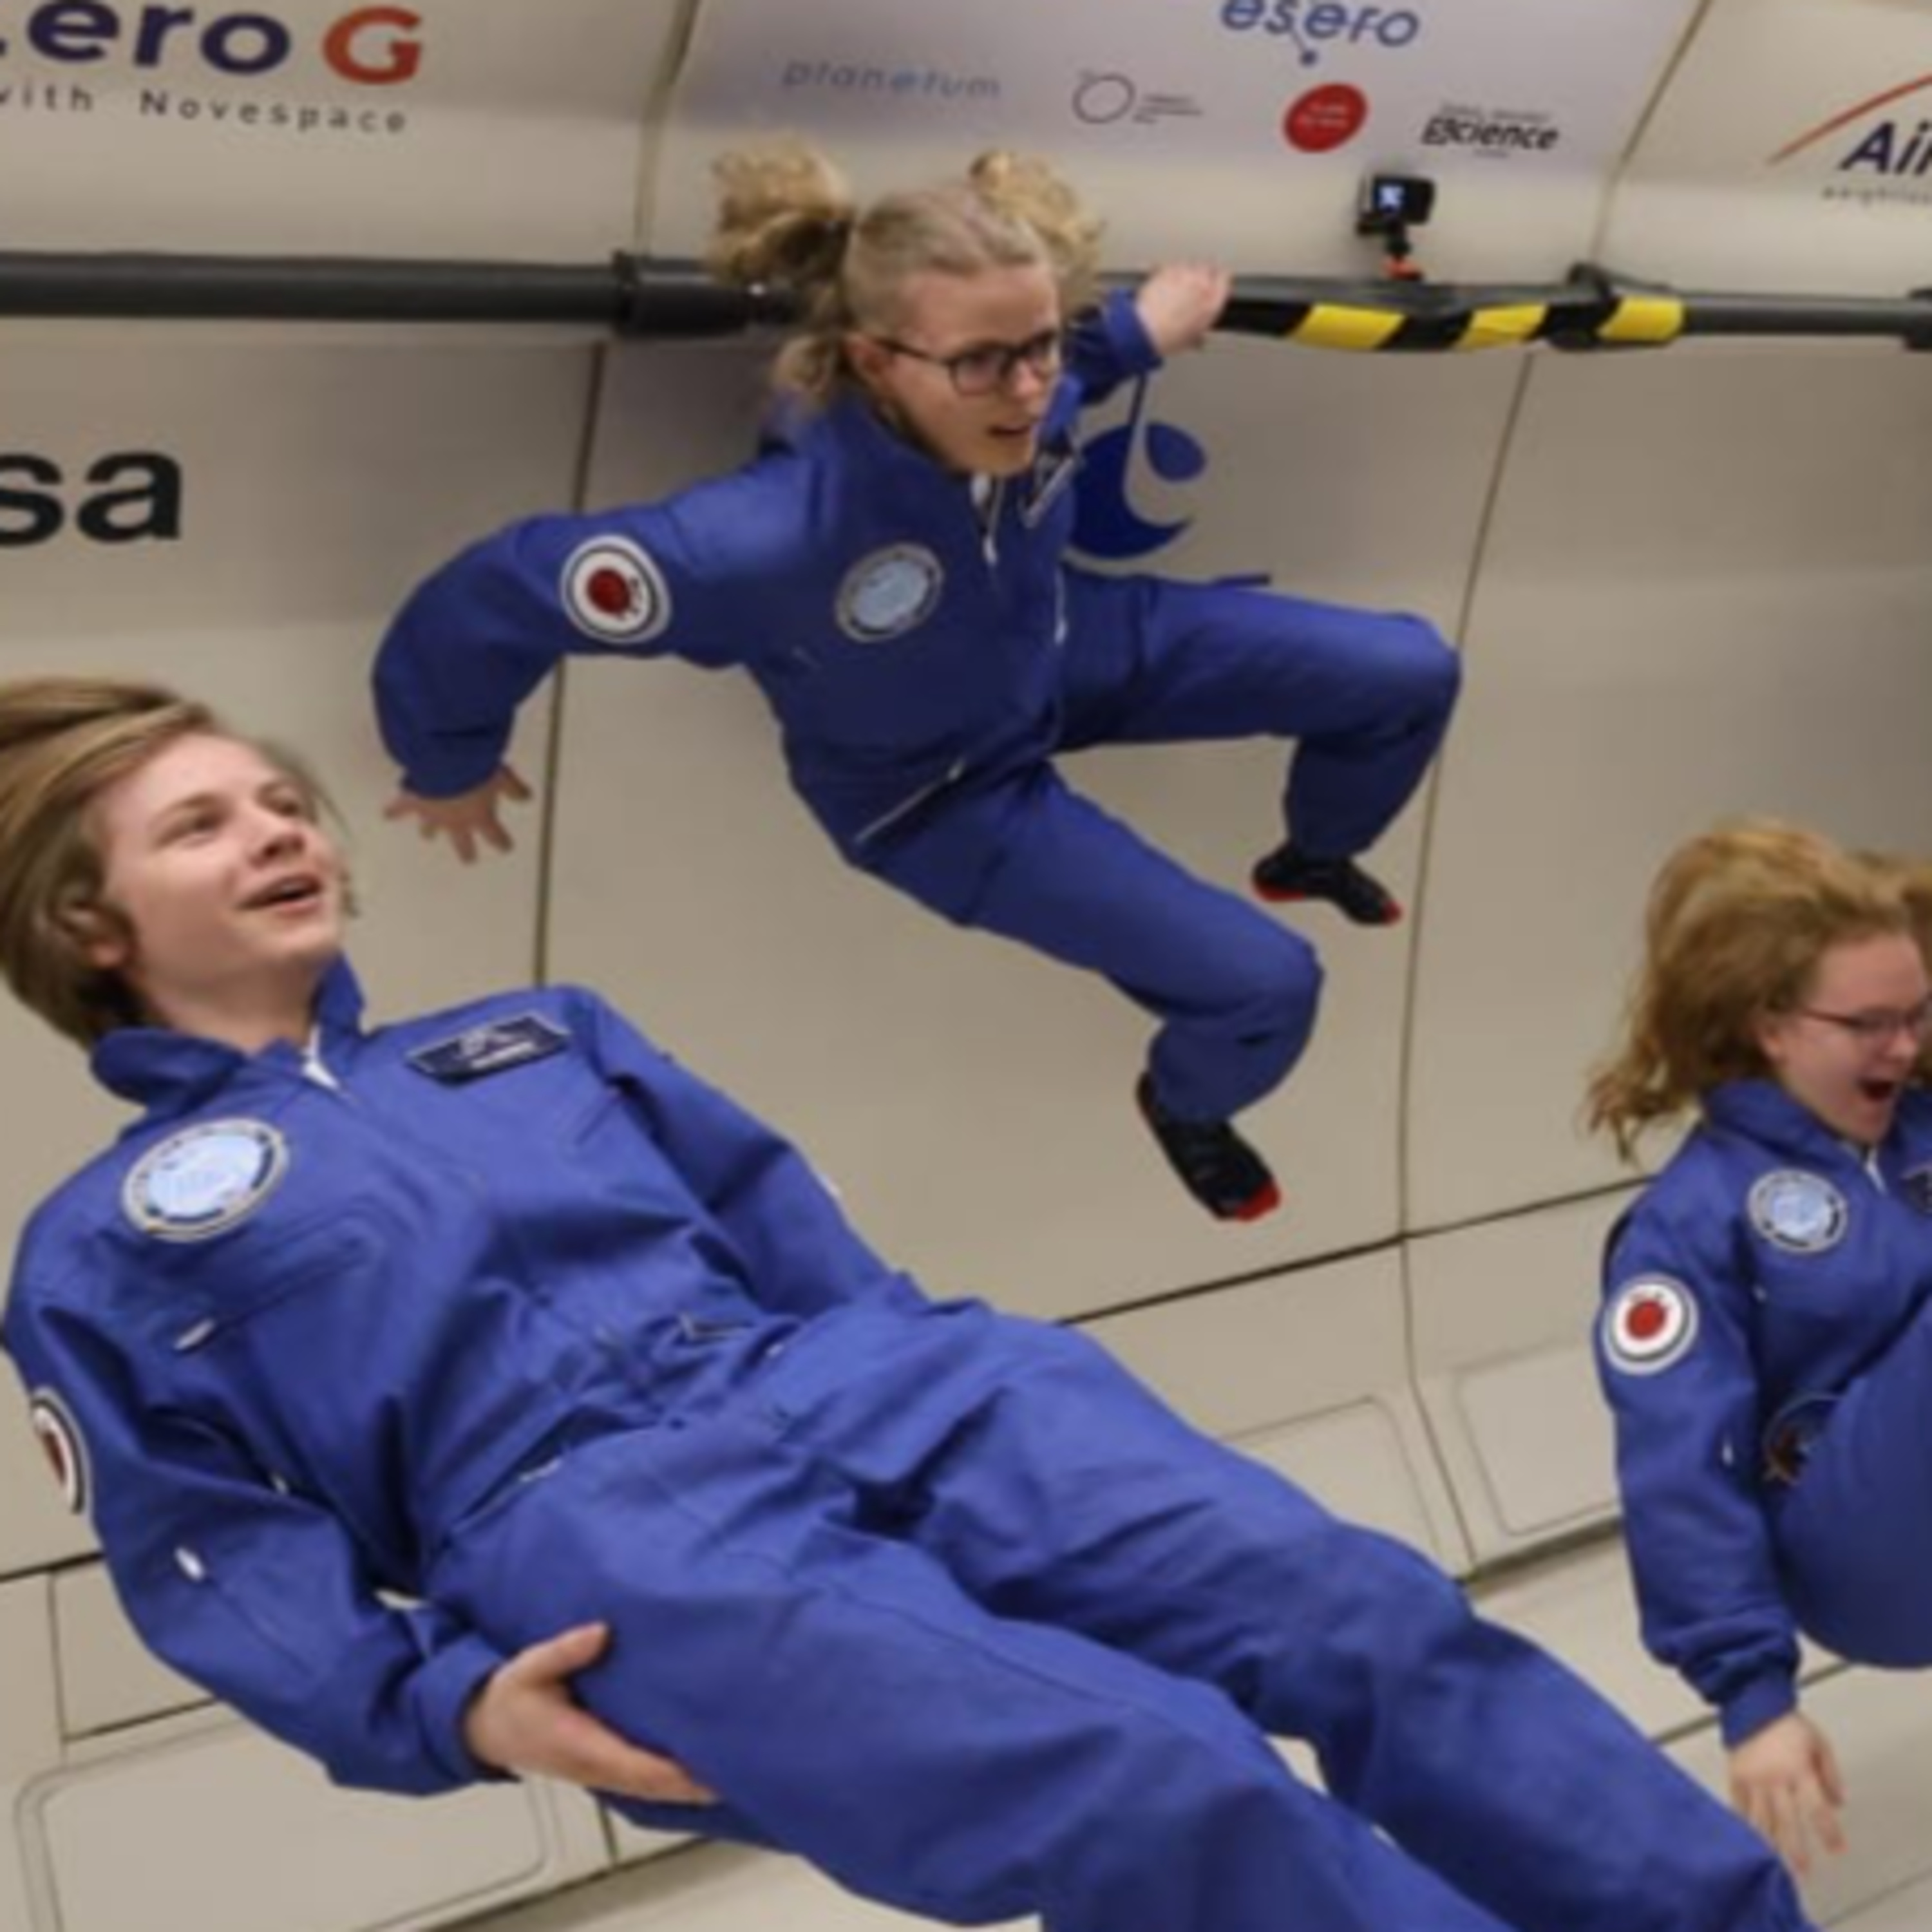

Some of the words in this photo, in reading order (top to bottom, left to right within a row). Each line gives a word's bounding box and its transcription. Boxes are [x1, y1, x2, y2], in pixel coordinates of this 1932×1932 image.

[0, 0, 292, 75] ero
[323, 5, 422, 86] G
[1220, 0, 1419, 48] esero
[139, 90, 406, 133] Novespace
